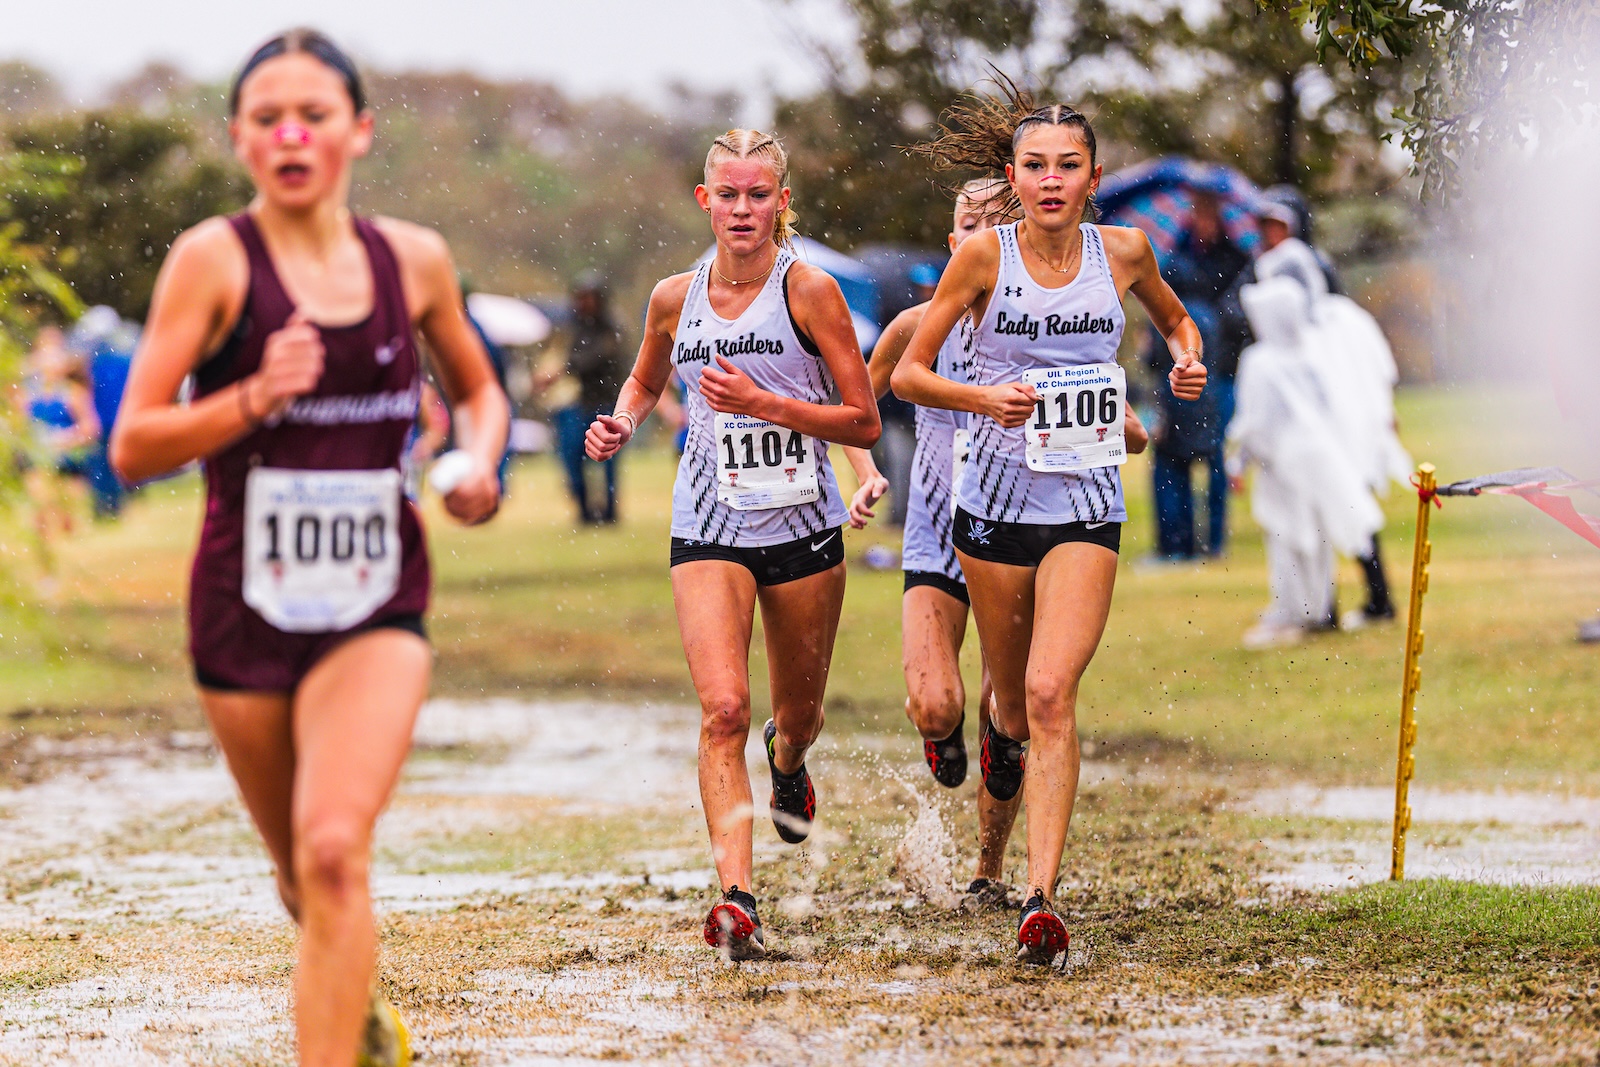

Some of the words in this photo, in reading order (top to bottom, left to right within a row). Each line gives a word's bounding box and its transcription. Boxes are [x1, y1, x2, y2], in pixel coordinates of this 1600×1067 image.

[994, 311, 1040, 341] Lady
[1045, 312, 1114, 336] Raiders
[677, 340, 711, 365] Lady
[714, 332, 784, 357] Raiders
[1036, 381, 1048, 389] XC
[1051, 376, 1112, 388] Championship
[1047, 370, 1062, 378] UIL
[1065, 368, 1095, 377] Region
[1033, 387, 1118, 430] 1106
[722, 430, 807, 470] 1104
[800, 488, 814, 496] 1104
[265, 512, 386, 561] 1000
